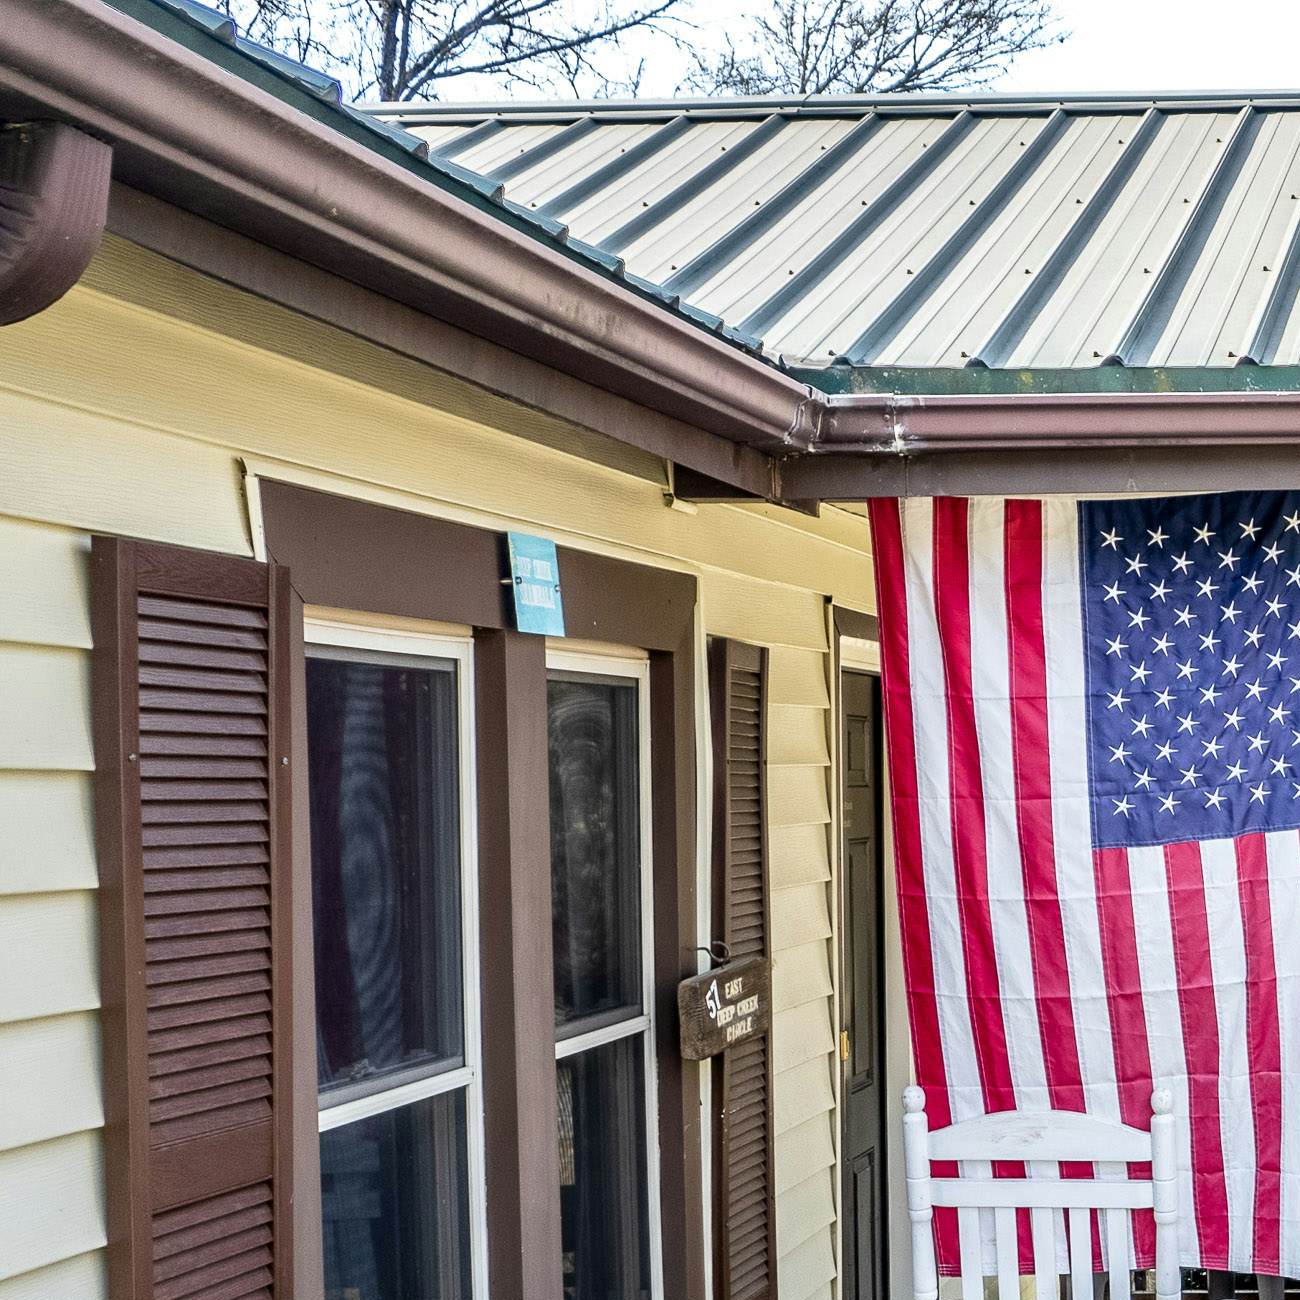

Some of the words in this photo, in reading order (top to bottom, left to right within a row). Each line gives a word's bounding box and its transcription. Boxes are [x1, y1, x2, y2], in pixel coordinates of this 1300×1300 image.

[705, 979, 721, 1019] 57
[724, 977, 743, 999] EAST
[716, 1004, 735, 1028] DEEP
[736, 993, 759, 1017] CREEK
[726, 1016, 752, 1042] CIRCLE
